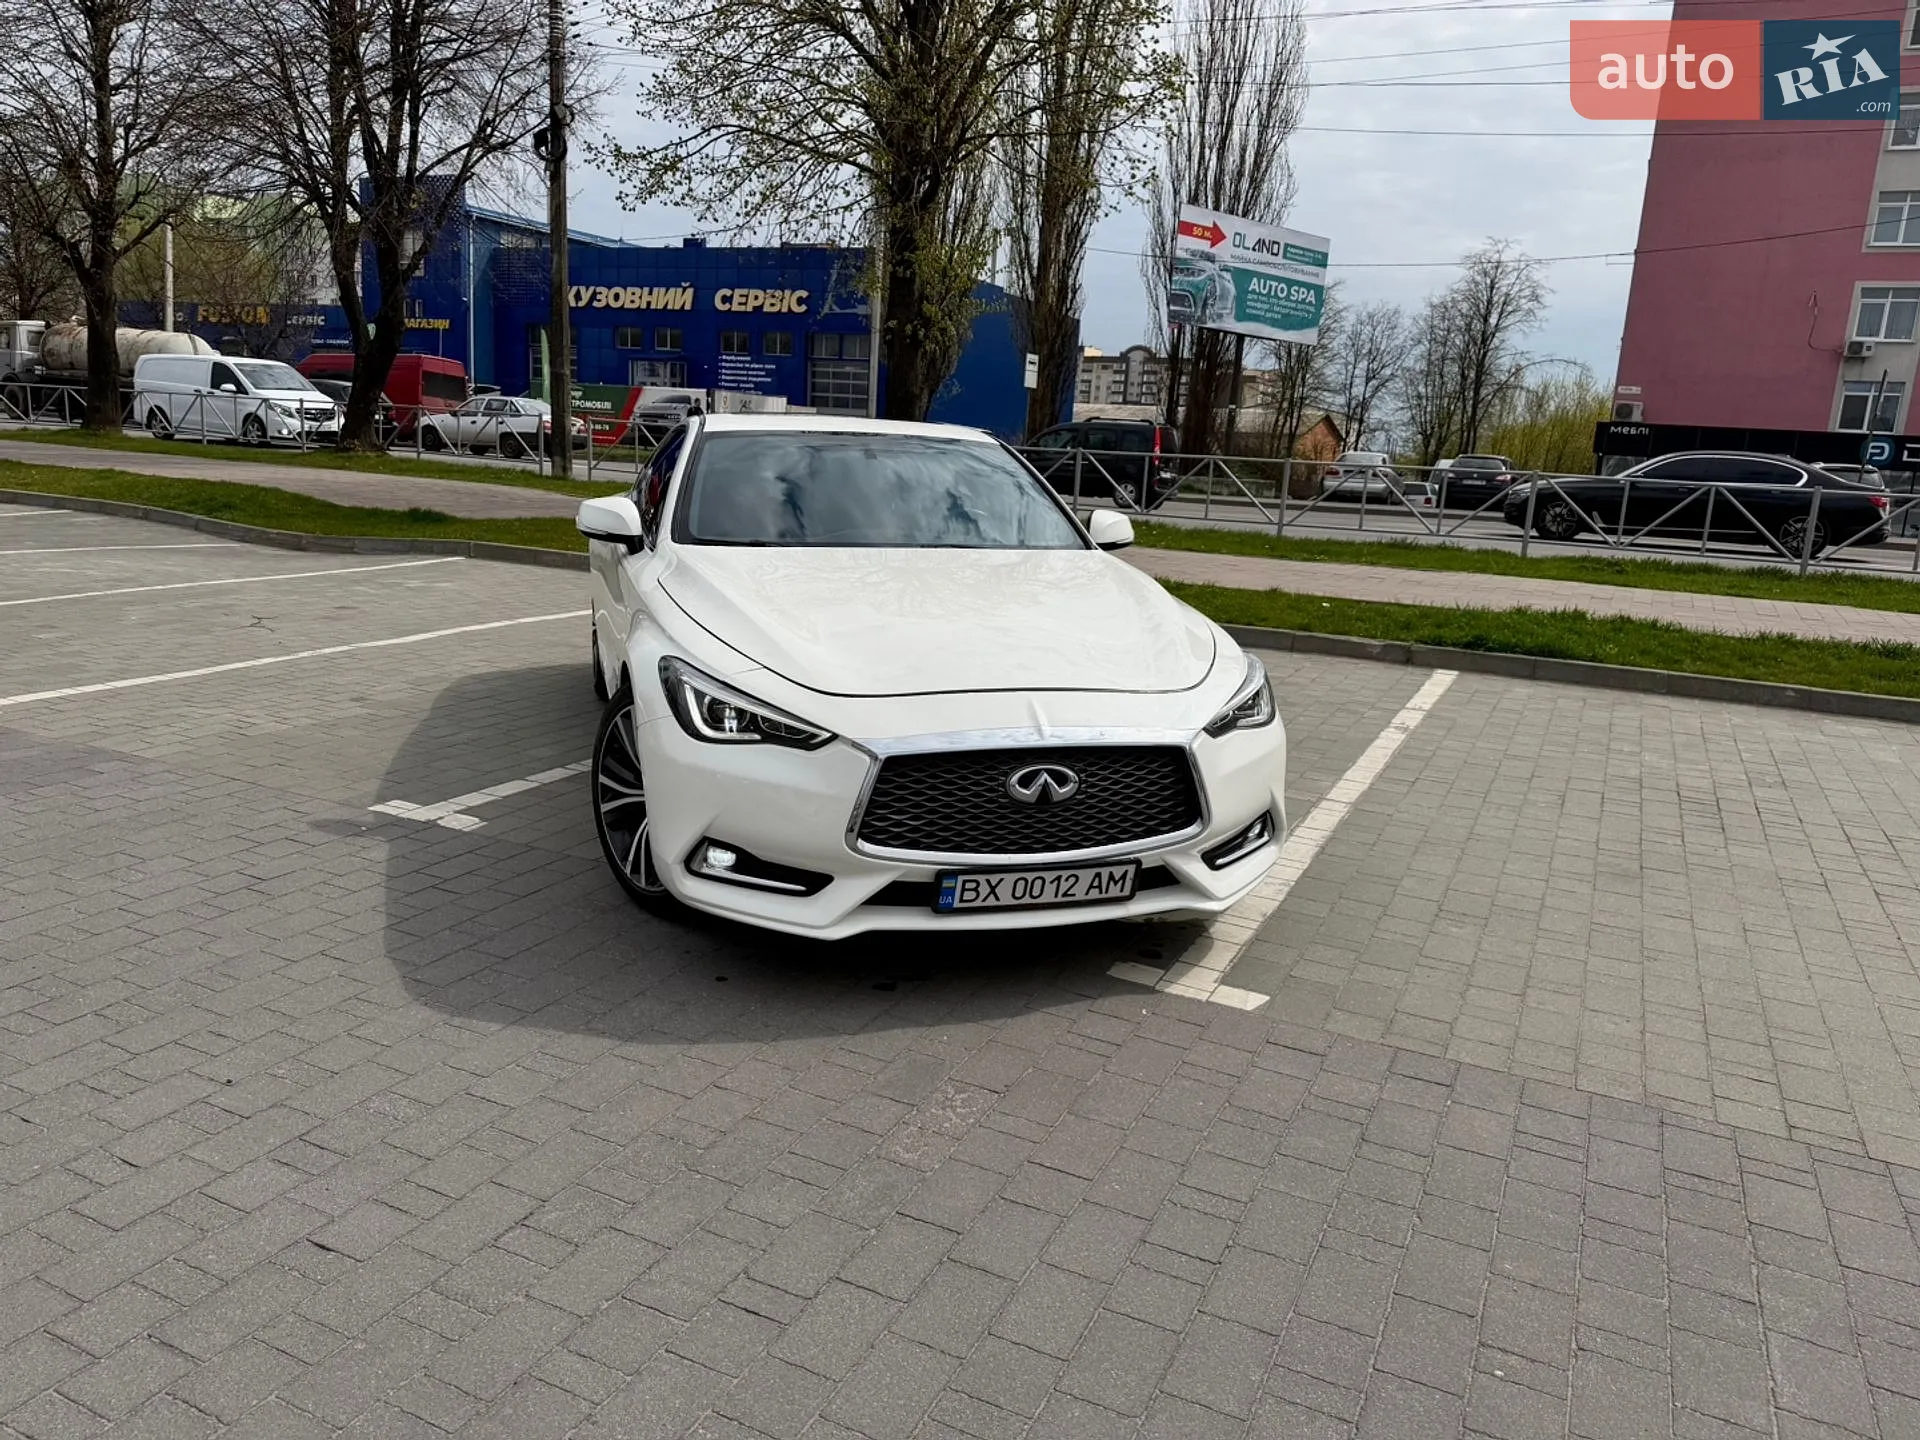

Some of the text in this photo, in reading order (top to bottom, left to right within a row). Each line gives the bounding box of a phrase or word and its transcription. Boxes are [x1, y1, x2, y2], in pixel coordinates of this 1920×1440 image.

[1192, 226, 1203, 237] 50
[1232, 231, 1281, 257] OLAND
[714, 287, 810, 314] СЕРВІС
[1248, 277, 1316, 305] AUTO SPA
[570, 400, 612, 409] ТРОМОБІЛІ
[938, 894, 953, 905] UA
[958, 869, 1130, 904] BX 0012 AM
